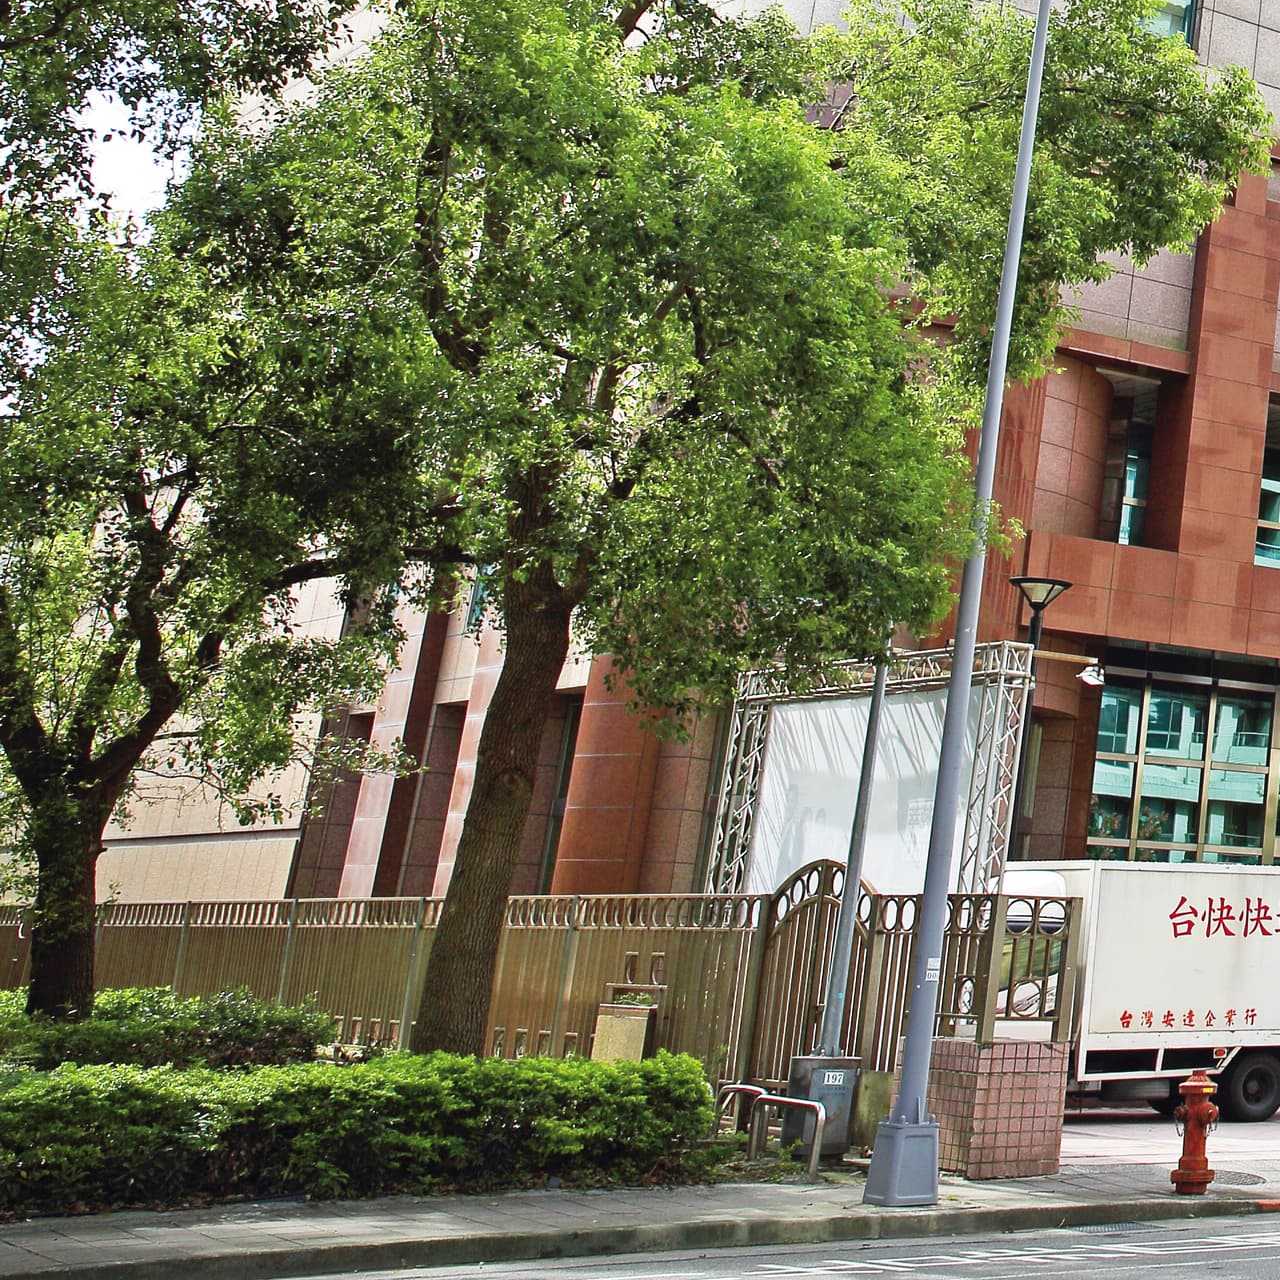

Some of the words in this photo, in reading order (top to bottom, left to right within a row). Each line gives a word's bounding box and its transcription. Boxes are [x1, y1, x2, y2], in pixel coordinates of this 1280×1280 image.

[1120, 1008, 1257, 1029] 台灣安達企業行
[826, 1073, 843, 1083] 197
